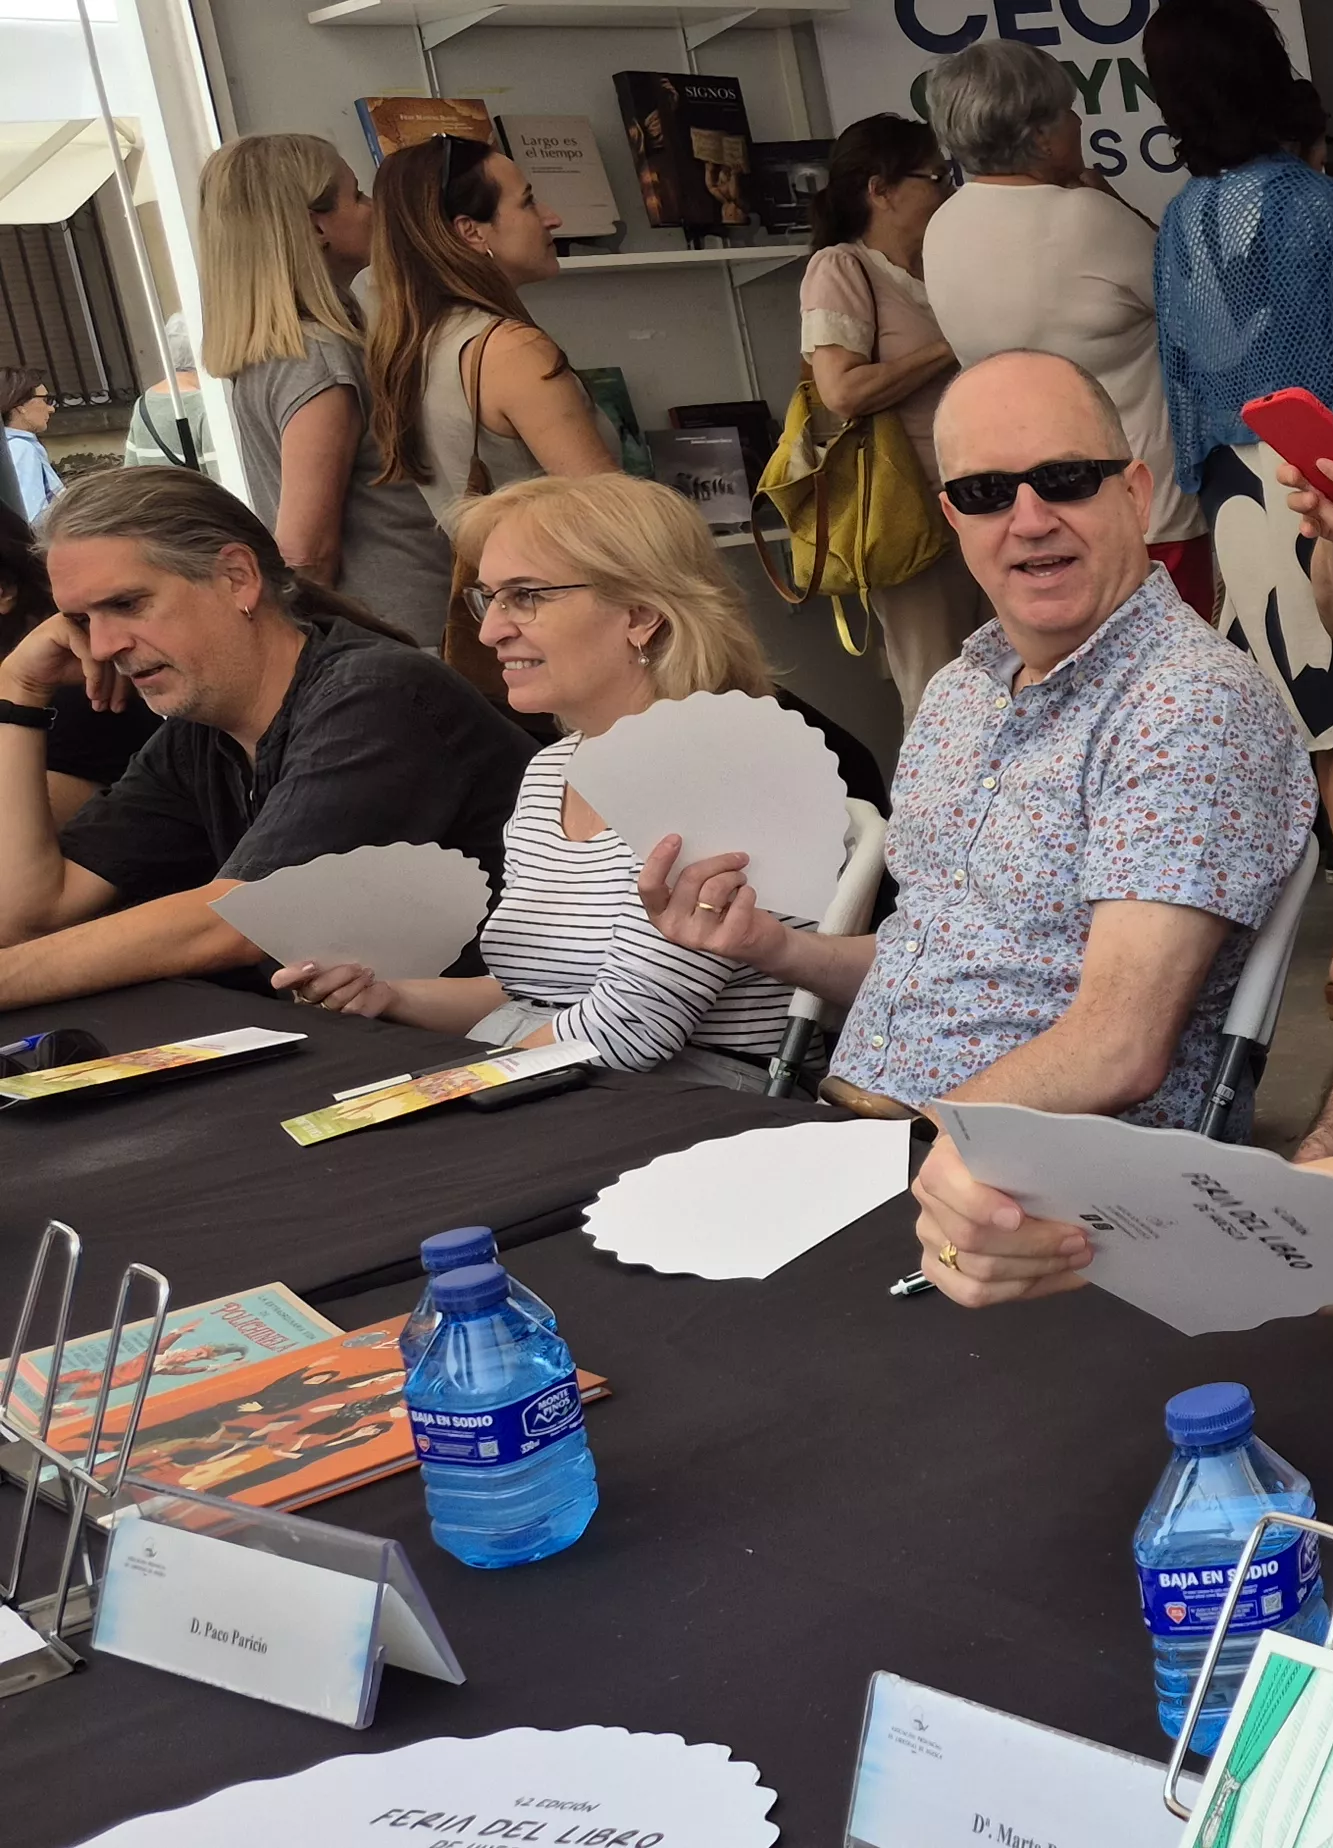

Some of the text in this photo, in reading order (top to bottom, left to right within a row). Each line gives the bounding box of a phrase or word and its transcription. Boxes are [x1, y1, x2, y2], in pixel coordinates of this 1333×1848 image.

[895, 0, 1152, 54] CEO
[685, 86, 737, 100] SIGNOS
[520, 134, 579, 150] Largo es
[525, 147, 584, 162] el tiempo
[1182, 1173, 1244, 1207] FERIA
[1228, 1210, 1270, 1233] DEL
[1258, 1235, 1314, 1270] LIBRO
[537, 1387, 572, 1416] MONTE PINOS
[411, 1411, 494, 1429] BAJA EN SODIO
[1158, 1560, 1279, 1590] BAJA EN SDIO
[190, 1616, 268, 1655] D. Paco Paricio
[535, 1797, 601, 1814] EDICIÓN
[369, 1808, 665, 1848] FERIA DEL LIBRO
